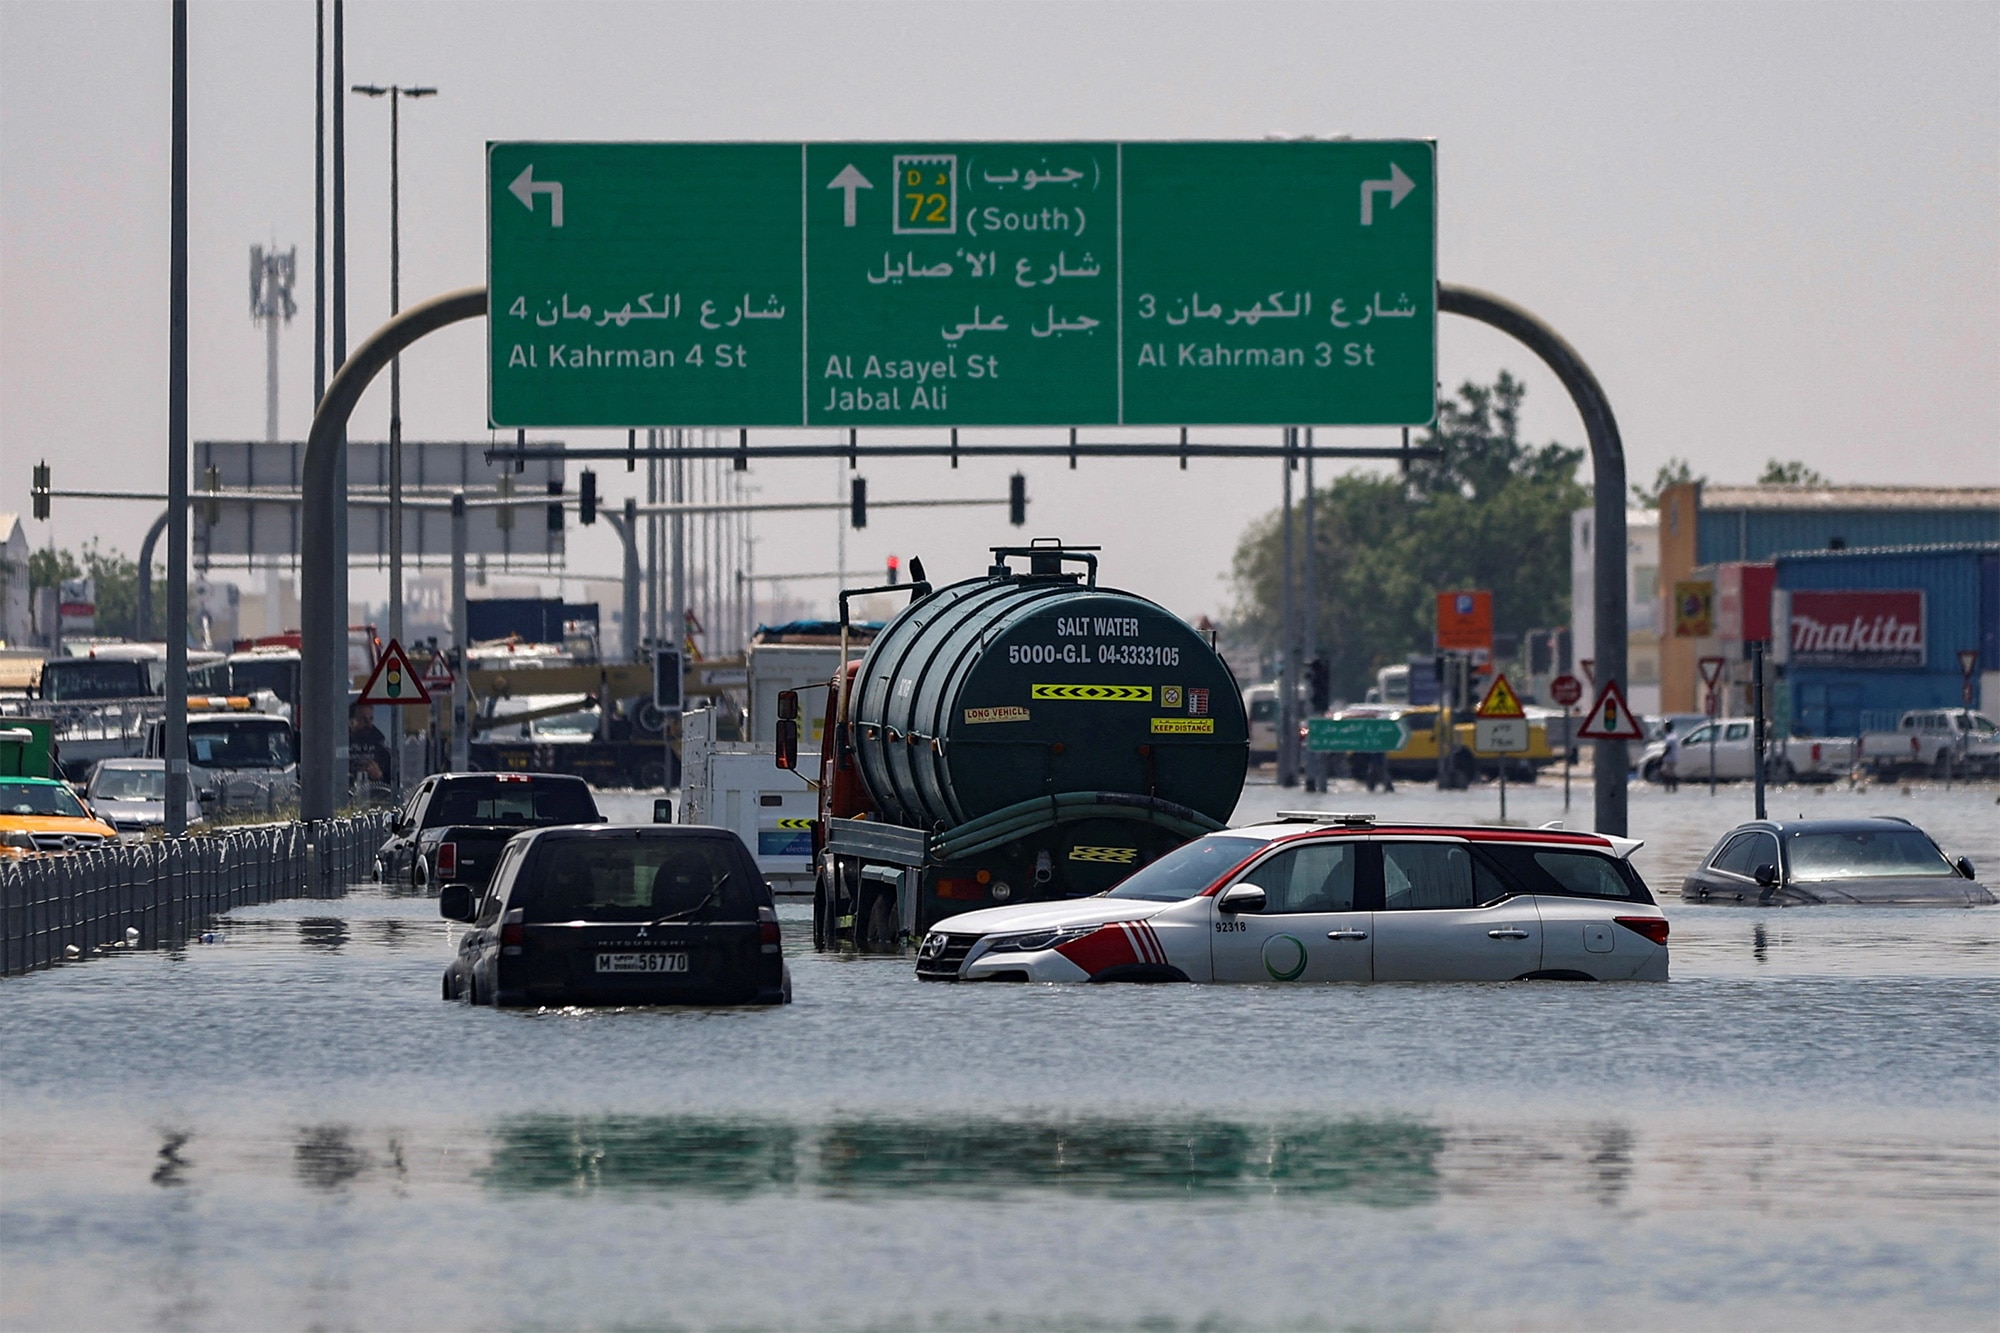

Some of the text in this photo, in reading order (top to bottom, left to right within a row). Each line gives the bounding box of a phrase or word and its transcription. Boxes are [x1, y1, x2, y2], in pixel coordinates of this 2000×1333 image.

[906, 170, 921, 186] D
[905, 193, 947, 222] 72
[966, 207, 1085, 236] (South)
[1015, 253, 1100, 287] شارع
[509, 293, 785, 329] شارع الكهرمان 4
[1139, 292, 1415, 328] شارع الكهرمان 3
[941, 306, 1100, 348] جبل علي
[509, 344, 746, 368] Al Kahrman 4 St
[1138, 342, 1374, 367] Al Kahrman 3 St
[825, 354, 998, 384] Al Asayel St
[825, 386, 947, 411] Jabal Ali
[1057, 617, 1139, 637] SALT WATER
[1009, 644, 1180, 666] 5000-G.L 04-3333105
[967, 710, 990, 718] LONG
[992, 707, 1028, 716] VEHICLE
[1154, 724, 1174, 732] KEEP
[1215, 921, 1247, 933] 92318
[600, 954, 686, 970] M 56770
